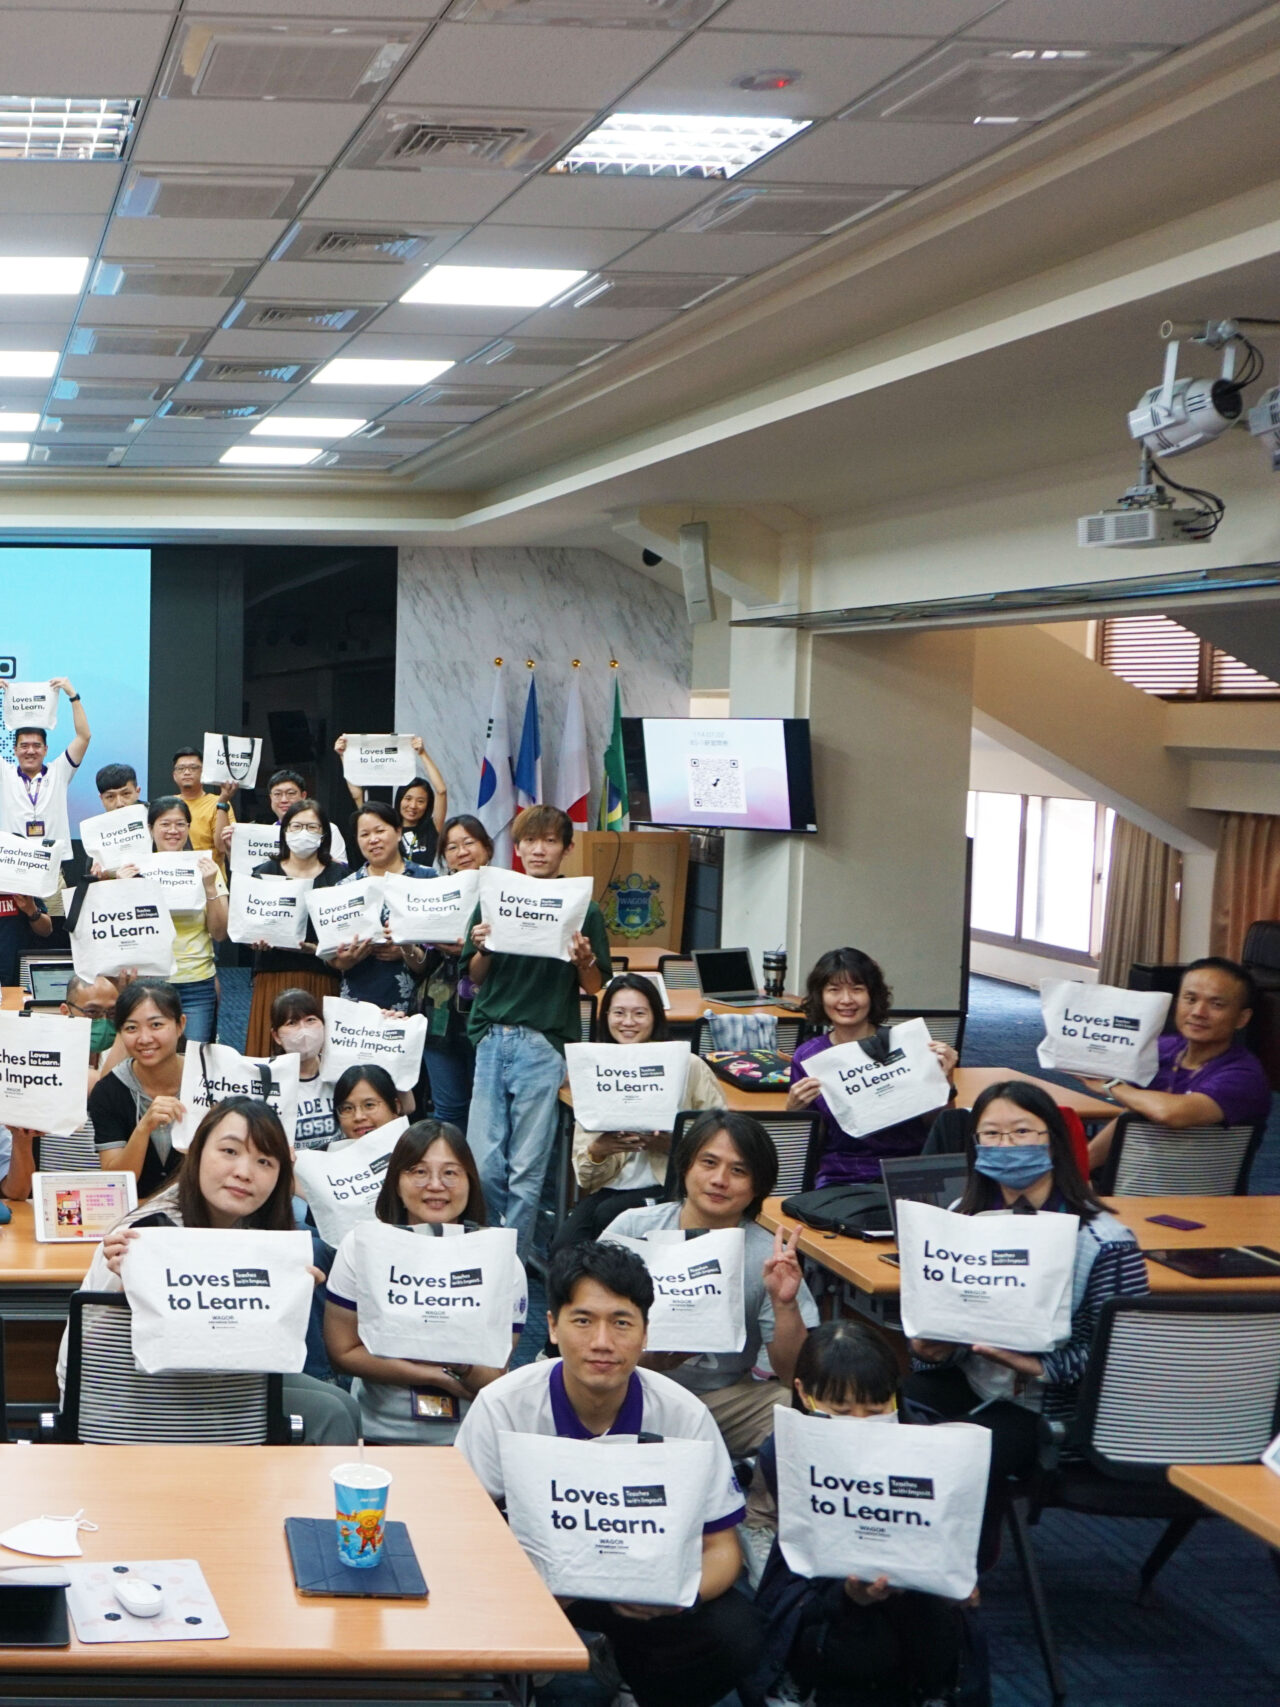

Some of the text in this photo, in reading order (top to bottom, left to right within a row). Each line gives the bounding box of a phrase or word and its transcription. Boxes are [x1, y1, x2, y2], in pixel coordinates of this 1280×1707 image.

[360, 747, 384, 755] Loves
[100, 827, 128, 840] Loves
[114, 833, 145, 845] Learn.
[248, 839, 273, 848] Loves
[0, 846, 32, 858] Teaches
[17, 858, 50, 871] Impact.
[159, 877, 197, 887] Impact.
[248, 894, 277, 907] Loves
[407, 893, 440, 903] Loves
[500, 891, 538, 907] Loves
[247, 906, 294, 918] to Learn.
[319, 903, 347, 916] Loves
[422, 904, 460, 912] Learn.
[499, 906, 559, 922] to Learn.
[91, 910, 133, 924] Loves
[320, 910, 364, 927] to Learn.
[92, 924, 159, 940] to Learn.
[1064, 1008, 1110, 1027] Loves
[335, 1021, 381, 1037] Teaches
[1062, 1025, 1135, 1046] to Learn.
[331, 1036, 405, 1053] with Impact.
[30, 1050, 50, 1059] Loves
[596, 1065, 638, 1078] Loves
[839, 1058, 881, 1081] Loves
[5, 1068, 63, 1088] Impact.
[596, 1079, 664, 1093] to Learn.
[845, 1066, 911, 1095] to Learn.
[327, 1170, 371, 1187] Loves
[334, 1190, 349, 1201] to
[924, 1240, 987, 1266] Loves
[166, 1268, 230, 1287] Loves
[390, 1265, 447, 1288] Loves
[652, 1273, 686, 1283] ves
[922, 1264, 1026, 1287] to Learn.
[387, 1289, 480, 1307] to Learn.
[658, 1283, 722, 1297] Learn.
[169, 1291, 270, 1310] to Learn.
[810, 1464, 885, 1496] Loves
[550, 1479, 621, 1507] Loves
[811, 1495, 931, 1527] to Learn.
[551, 1508, 665, 1534] to Learn.
